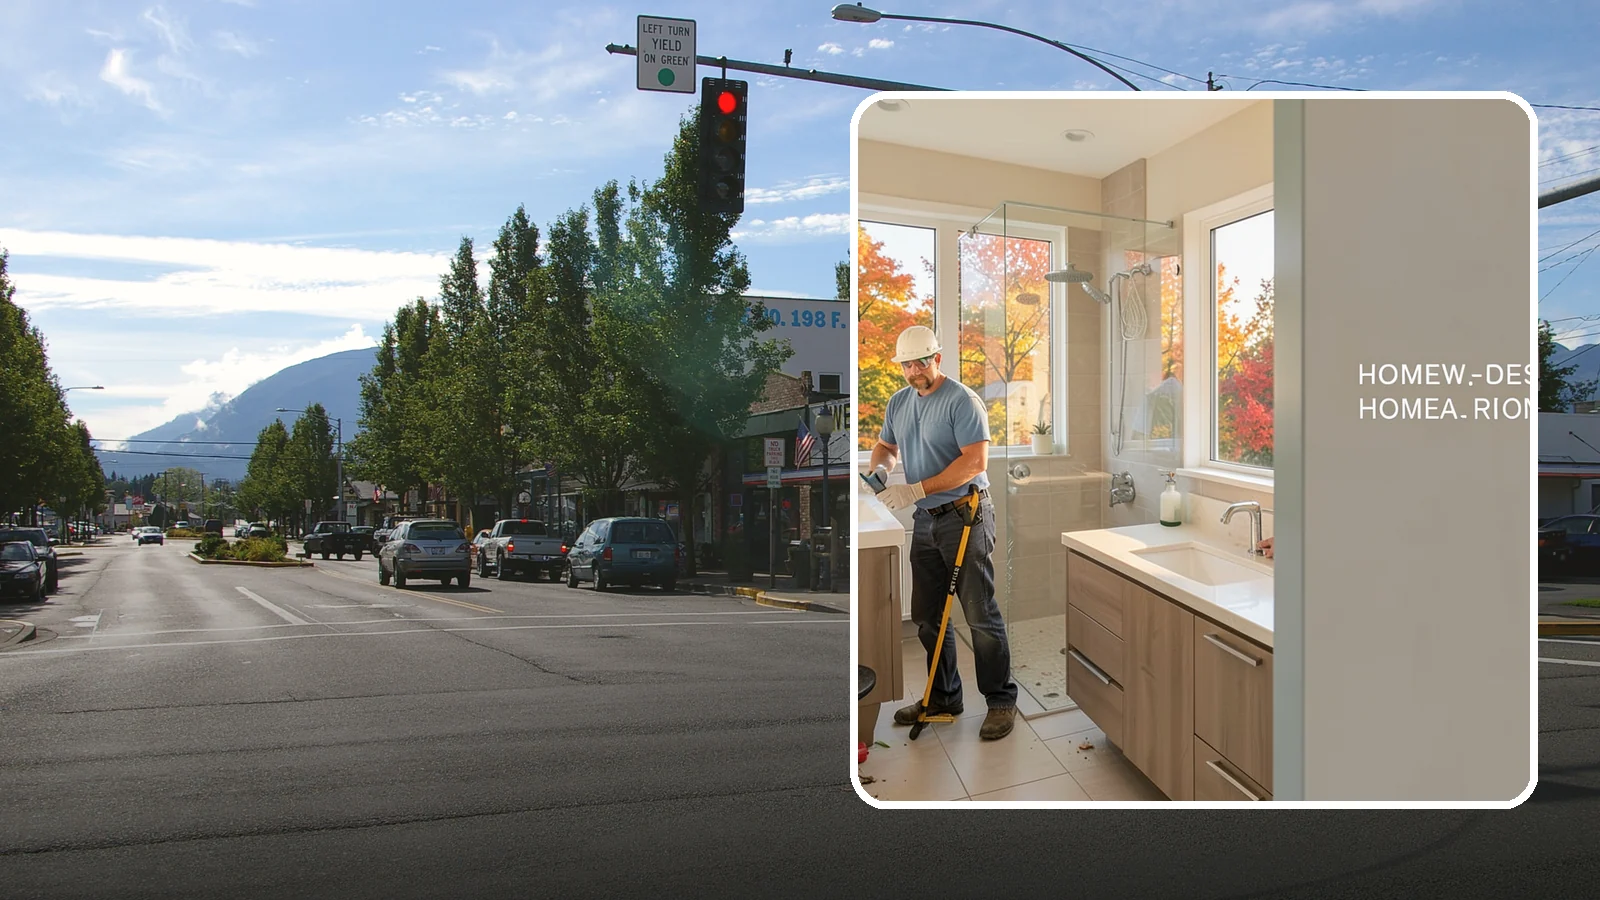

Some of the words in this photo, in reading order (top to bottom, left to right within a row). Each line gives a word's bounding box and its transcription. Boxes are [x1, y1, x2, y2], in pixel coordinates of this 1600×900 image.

[643, 24, 663, 34] LEFT
[668, 26, 690, 36] TURN
[652, 38, 682, 51] YIELD
[644, 53, 656, 63] ON
[661, 55, 689, 66] GREEN
[791, 309, 826, 328] 198
[831, 311, 846, 328] F.
